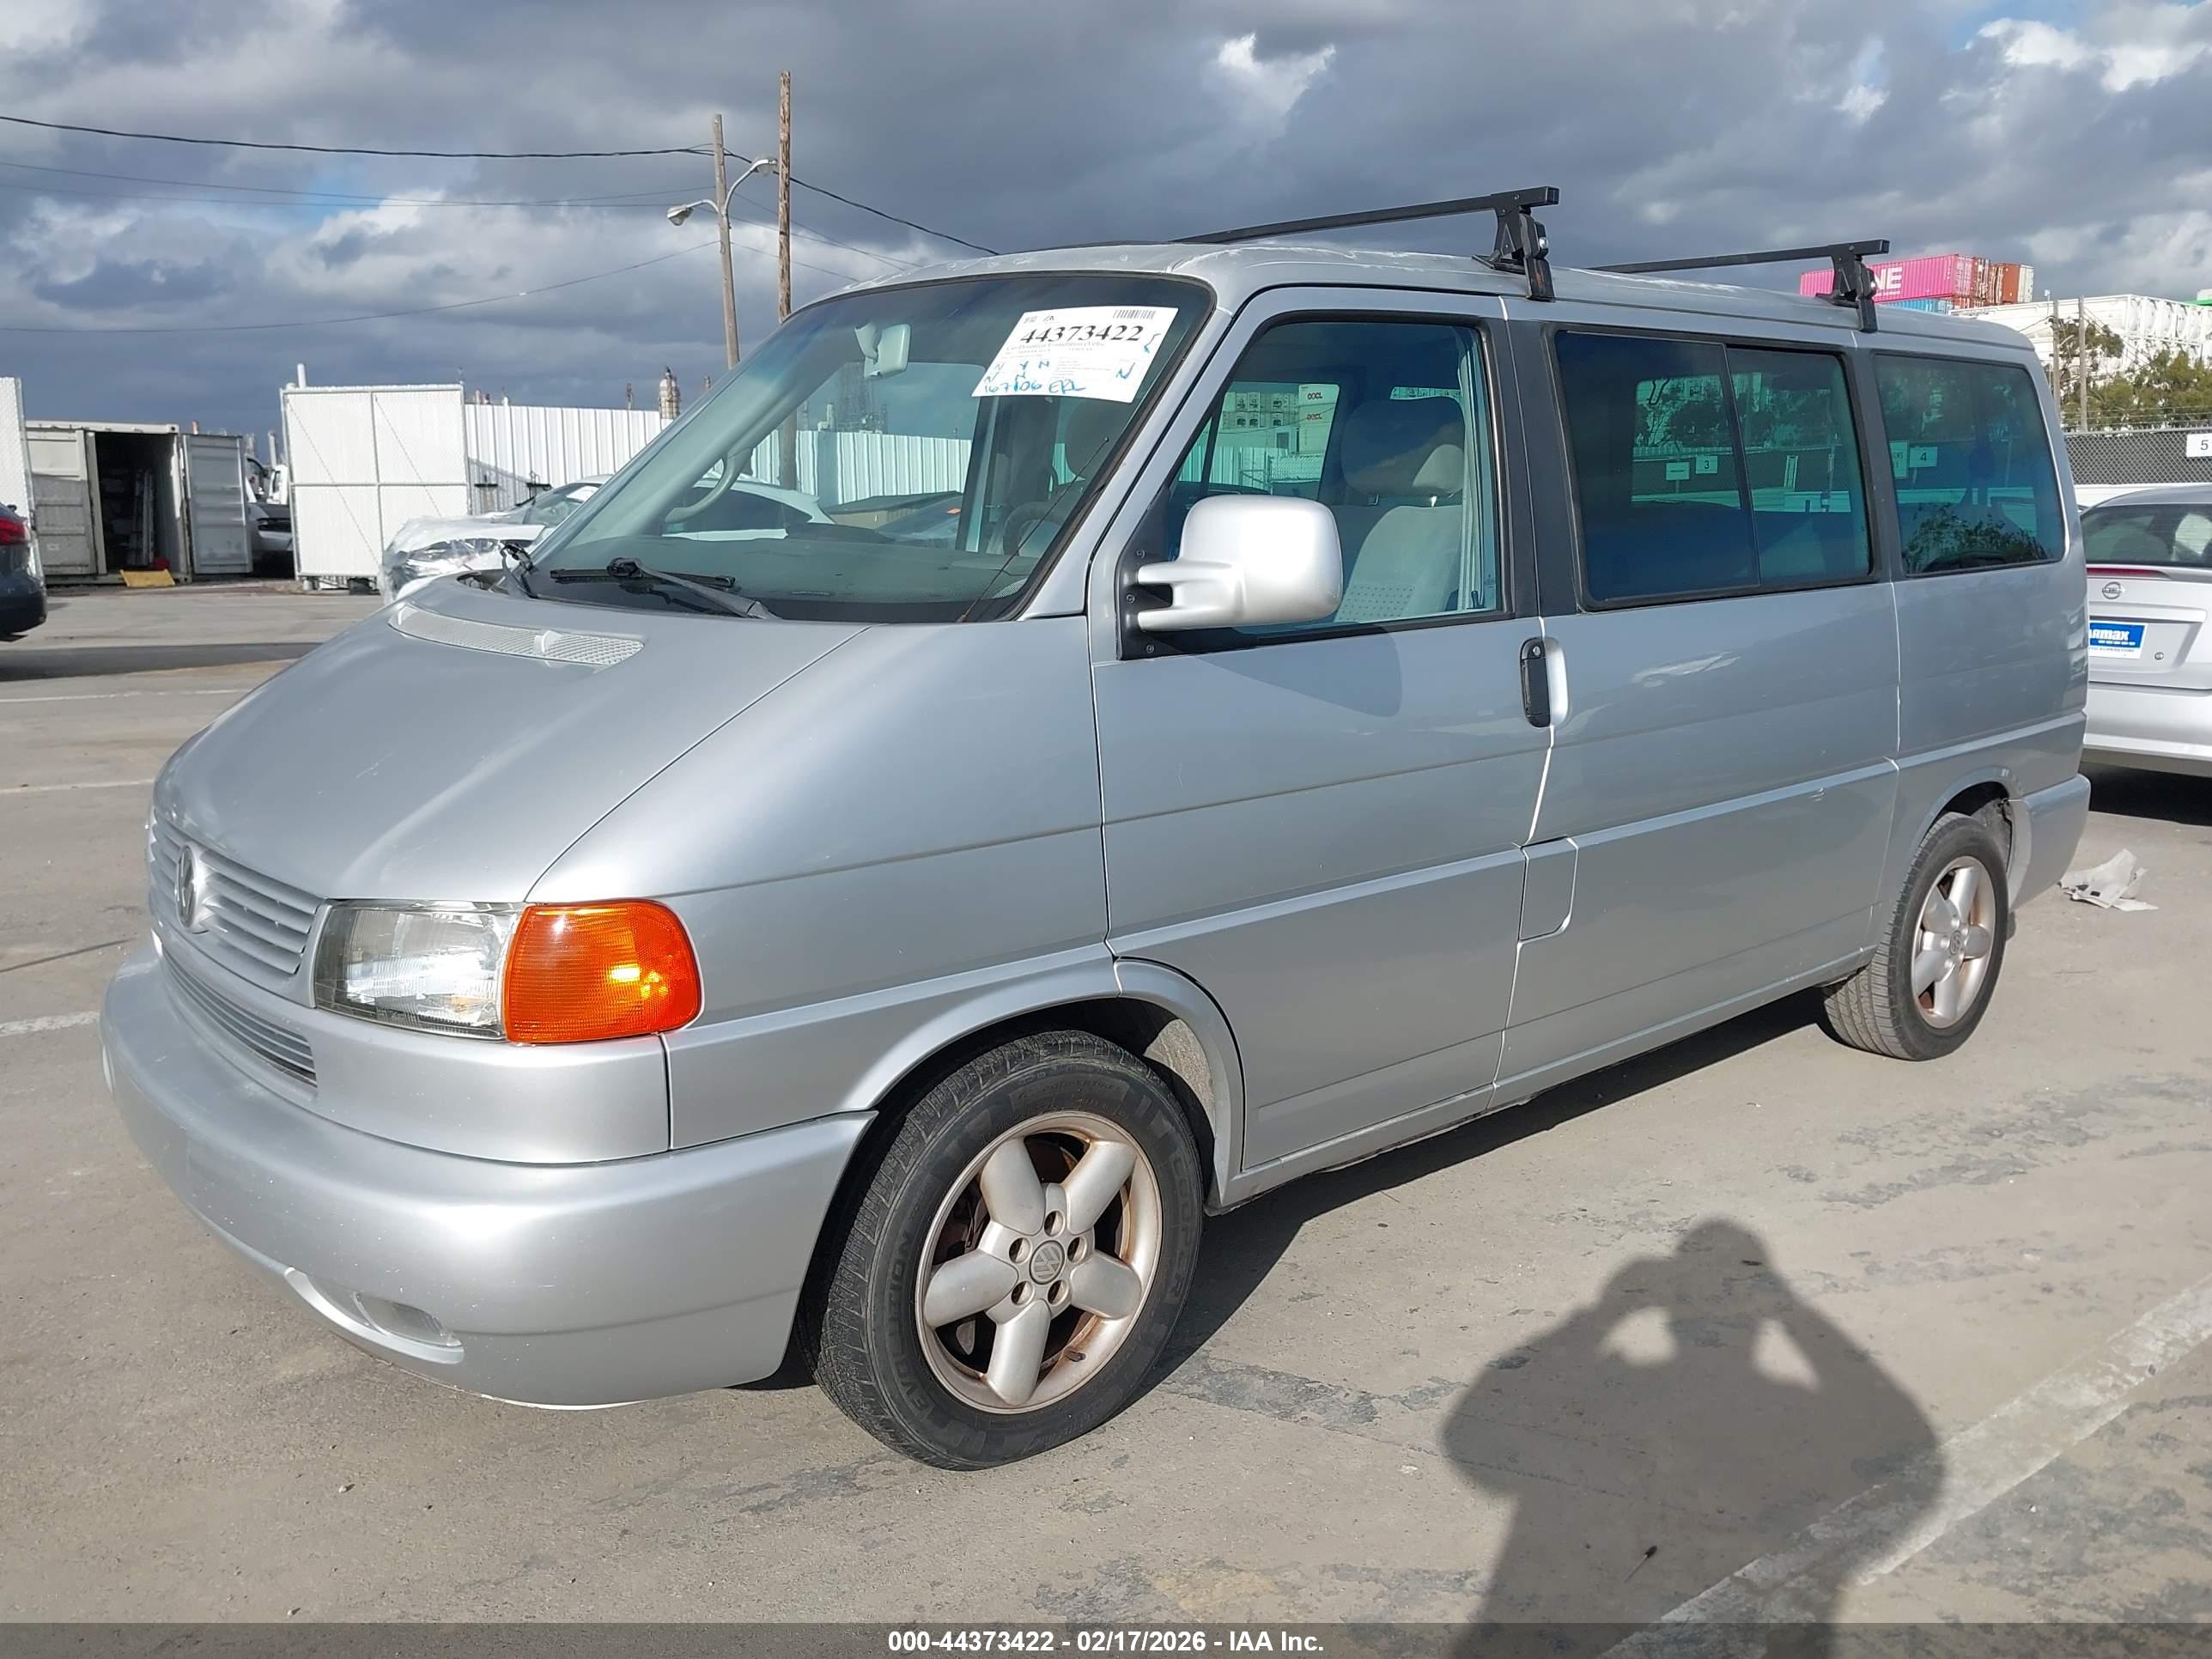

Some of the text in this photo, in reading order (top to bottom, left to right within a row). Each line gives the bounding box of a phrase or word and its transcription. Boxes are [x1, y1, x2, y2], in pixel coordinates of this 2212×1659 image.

[1020, 325, 1144, 343] 44373422
[1038, 361, 1049, 369] N
[1307, 392, 1323, 400] OOCL
[2200, 439, 2209, 451] 5
[1920, 452, 1927, 461] 4
[1704, 460, 1710, 470] 3
